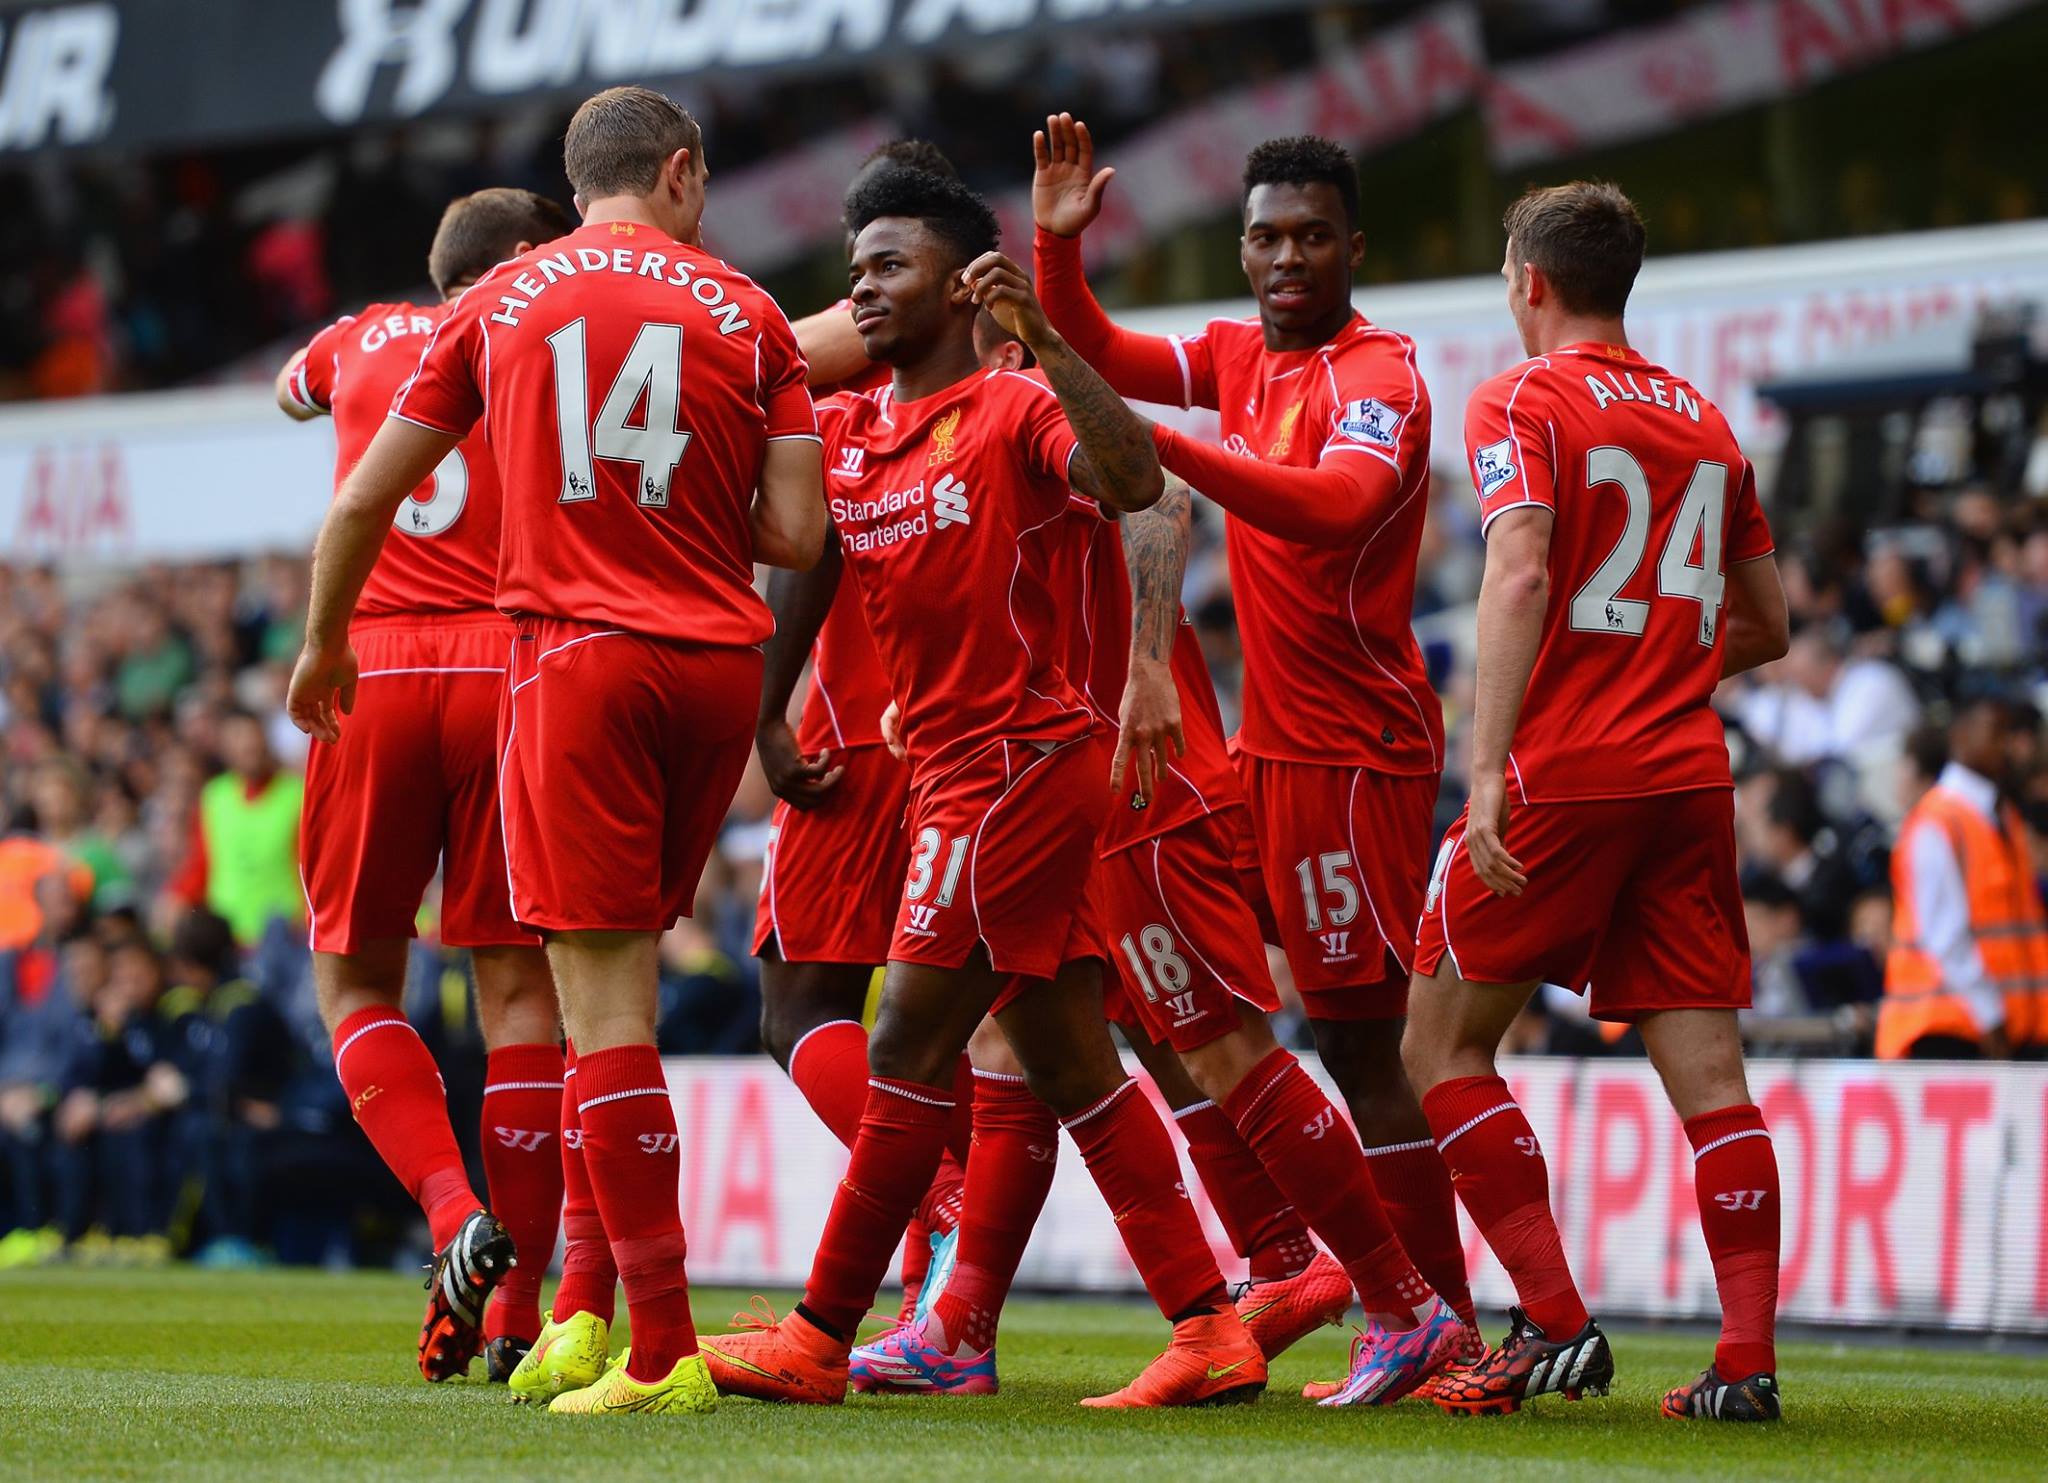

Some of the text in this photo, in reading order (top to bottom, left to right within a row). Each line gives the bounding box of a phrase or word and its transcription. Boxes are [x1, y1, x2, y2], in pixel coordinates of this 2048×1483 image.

[491, 248, 751, 336] HENDERSON
[361, 315, 433, 353] GER
[545, 316, 692, 508] 14
[1584, 370, 1701, 423] ALLEN
[831, 480, 925, 523] Standard
[841, 510, 928, 555] hartered
[1569, 445, 1729, 649] 24
[906, 827, 971, 908] 31
[1296, 850, 1360, 932] 15
[1120, 924, 1191, 1003] 18
[684, 1072, 780, 1266] IA
[1468, 1076, 1994, 1314] PORT
